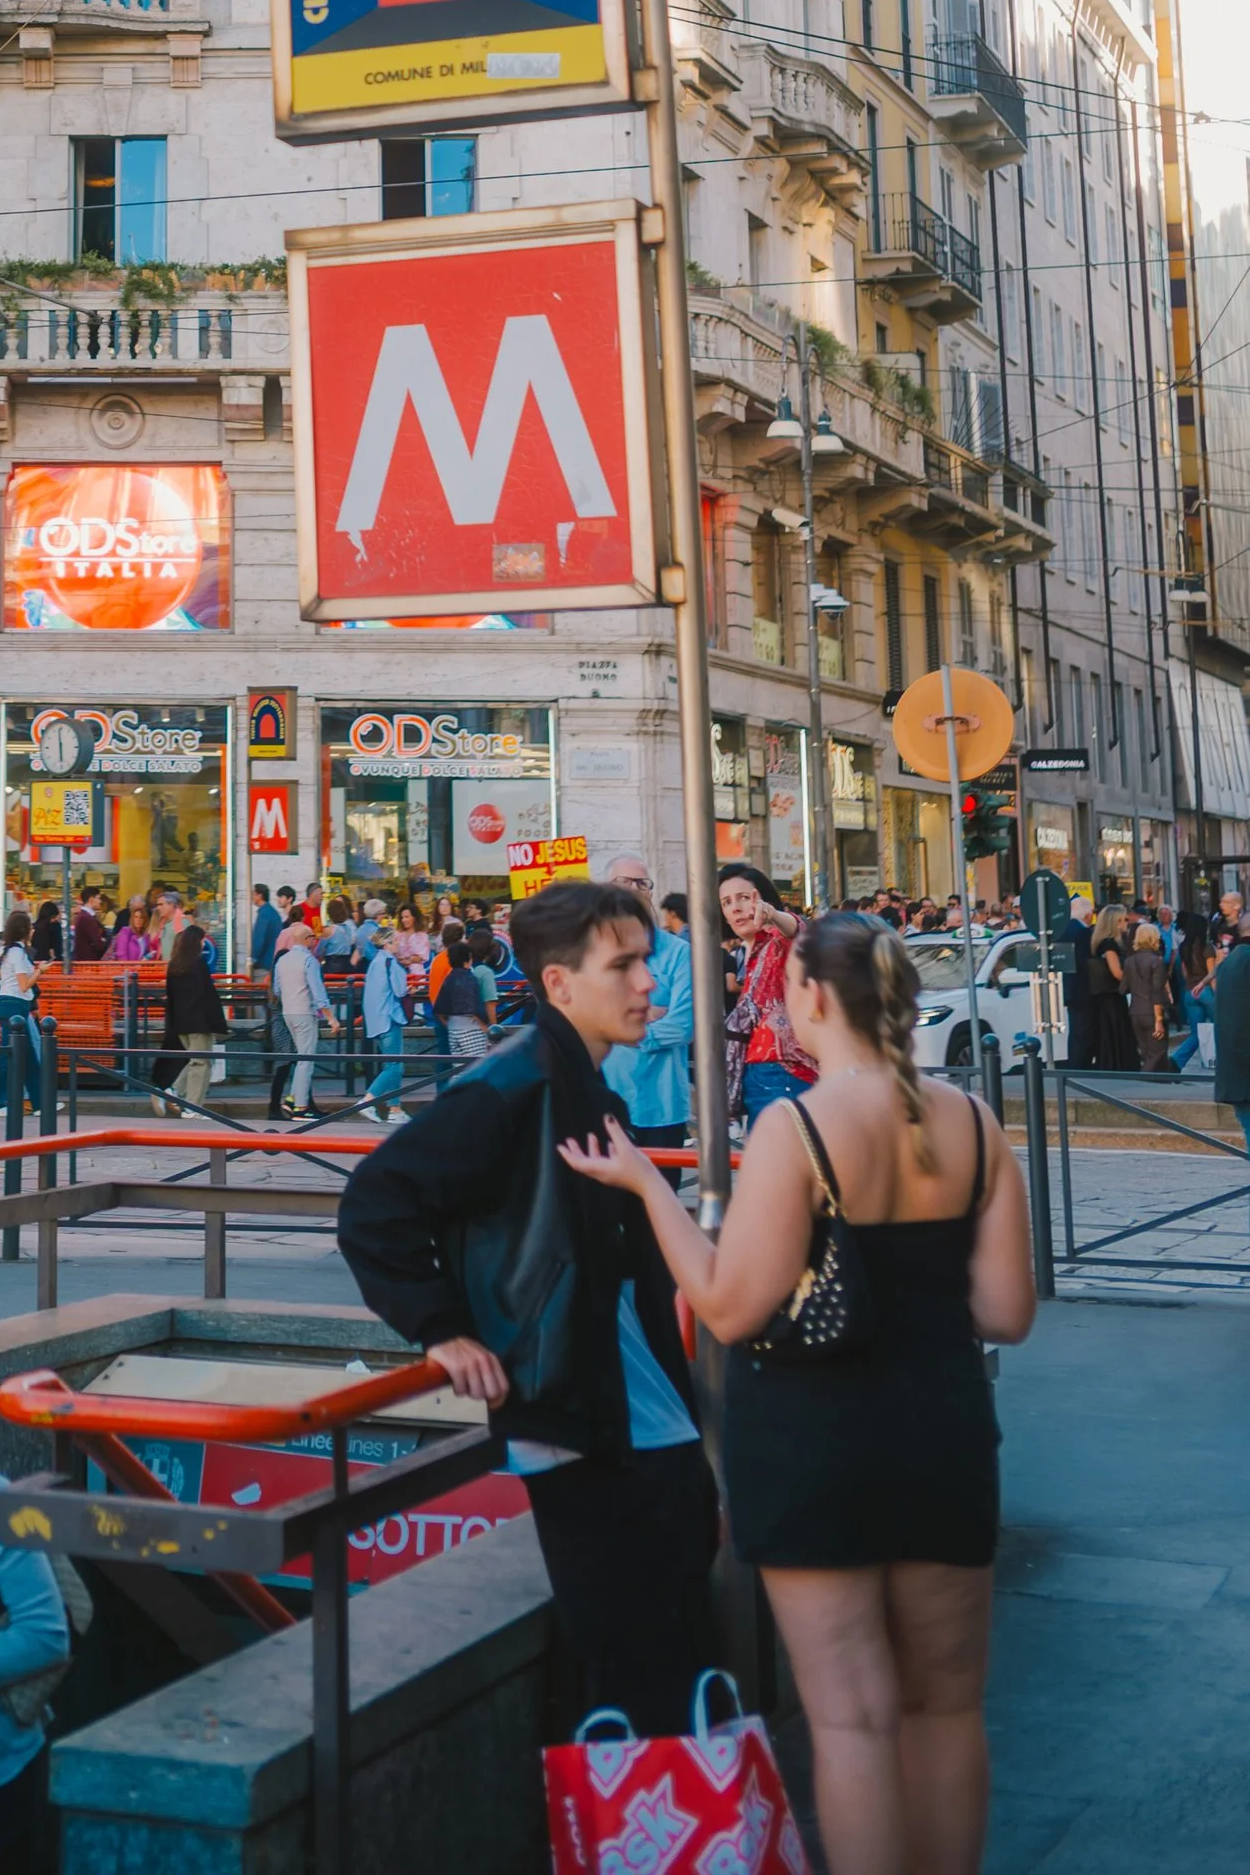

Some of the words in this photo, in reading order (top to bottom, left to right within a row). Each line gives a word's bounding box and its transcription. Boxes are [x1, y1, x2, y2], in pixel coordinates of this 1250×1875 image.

[364, 65, 433, 86] COMUNE
[439, 64, 455, 77] DI
[335, 314, 617, 532] M
[39, 517, 196, 557] ODStore
[55, 561, 178, 579] ITALIA
[578, 661, 618, 670] PIAZZA
[580, 673, 617, 682] DUOMO
[350, 713, 520, 759] ODStore
[102, 760, 147, 772] DOLCE
[148, 761, 202, 772] SALATO
[350, 763, 419, 777] OVUNQUE
[421, 764, 466, 776] DOLCE
[468, 765, 523, 777] SALATO
[1030, 759, 1086, 769] CALZEDONIA
[251, 797, 288, 838] M
[508, 843, 534, 868] NO
[535, 836, 588, 865] JESUS
[348, 1438, 385, 1458] ines
